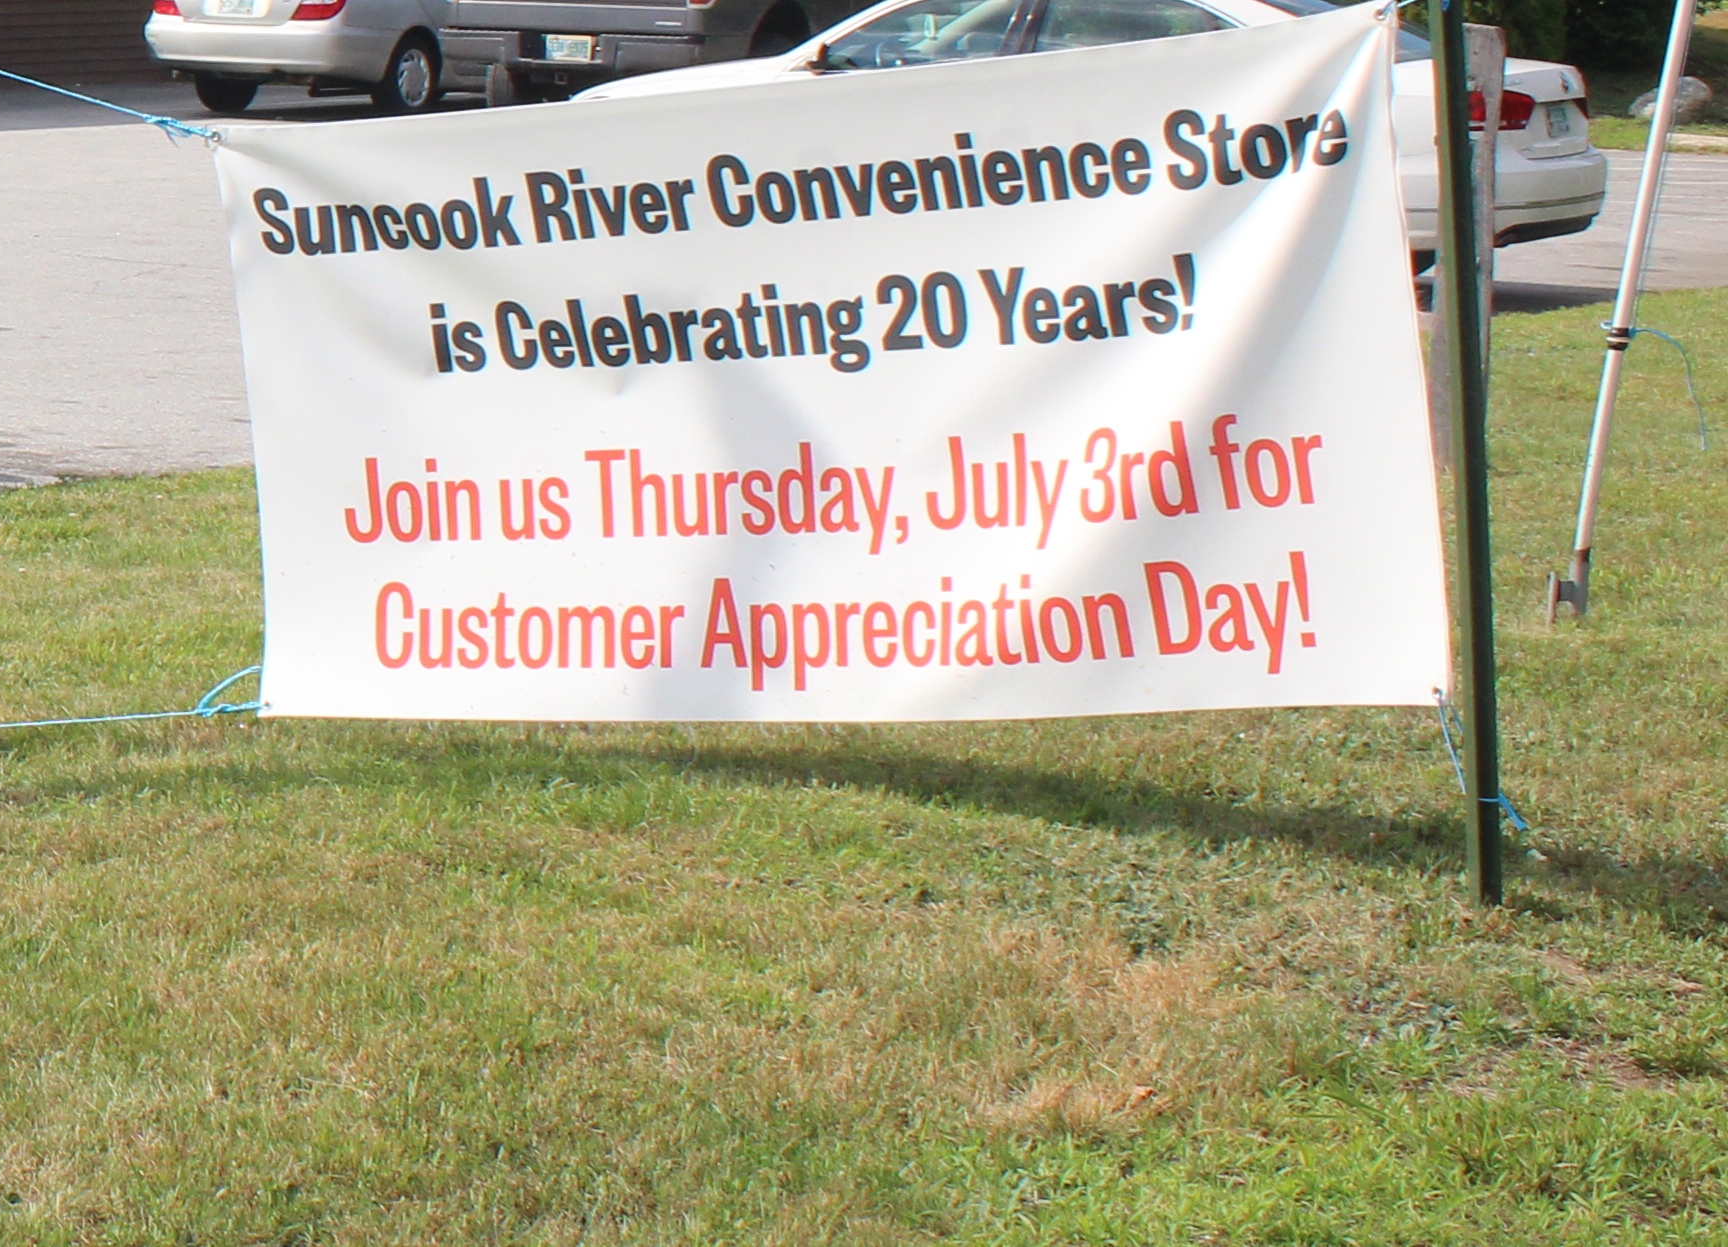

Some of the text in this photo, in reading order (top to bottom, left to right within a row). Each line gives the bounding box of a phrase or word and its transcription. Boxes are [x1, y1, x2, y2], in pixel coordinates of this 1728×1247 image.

[254, 108, 1350, 257] Suncook River Convenience Store
[430, 253, 1198, 374] is Celebrating 20 Years!
[343, 413, 1323, 556] Join us Thursday, July 3rd for
[374, 549, 1317, 693] Customer Appreciation Day!
